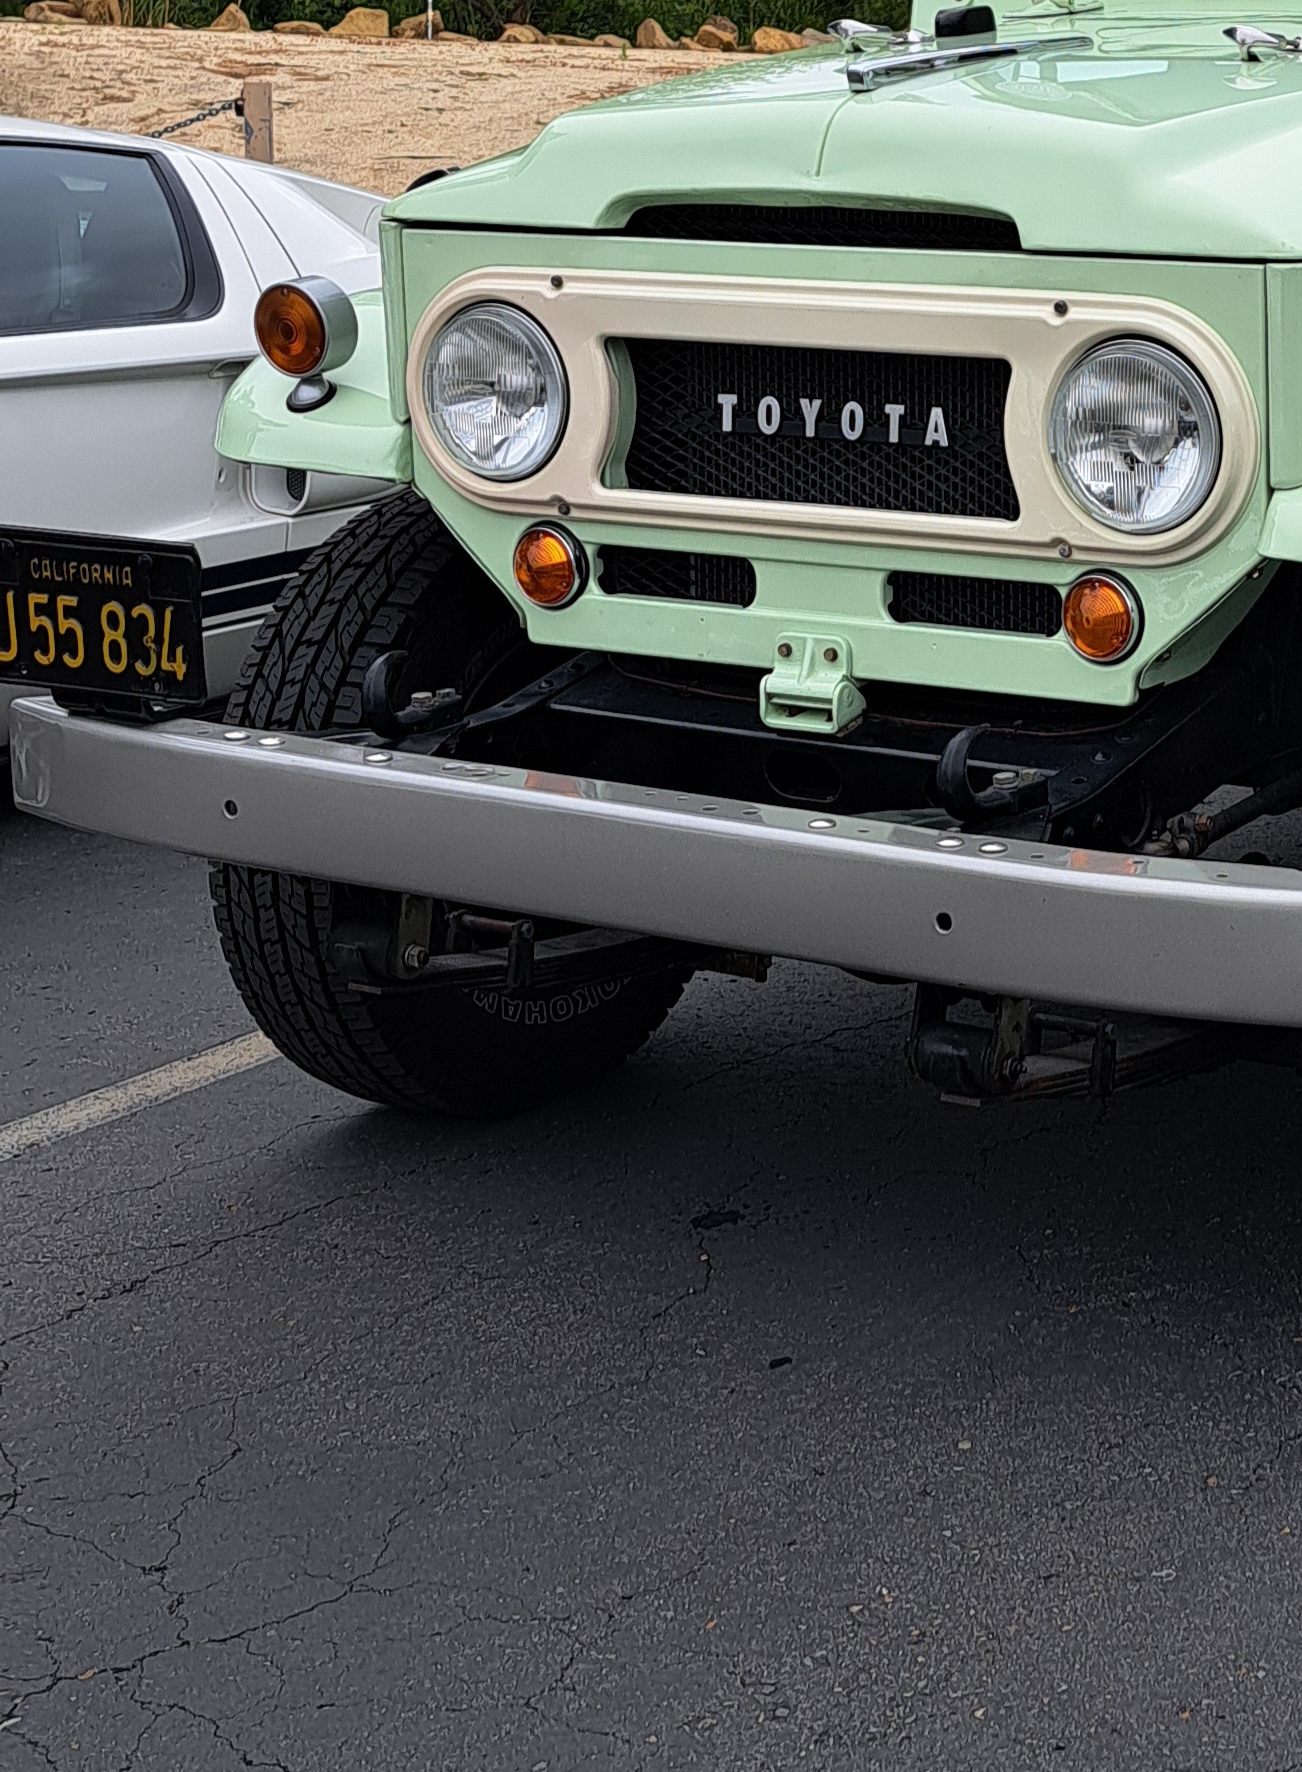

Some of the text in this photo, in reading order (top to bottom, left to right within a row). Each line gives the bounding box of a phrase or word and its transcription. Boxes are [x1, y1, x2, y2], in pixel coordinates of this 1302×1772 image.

[717, 393, 949, 447] TOYOTA
[30, 557, 133, 587] CALIFORNIA
[100, 600, 187, 681] 834
[461, 977, 632, 1025] OKOHAM
